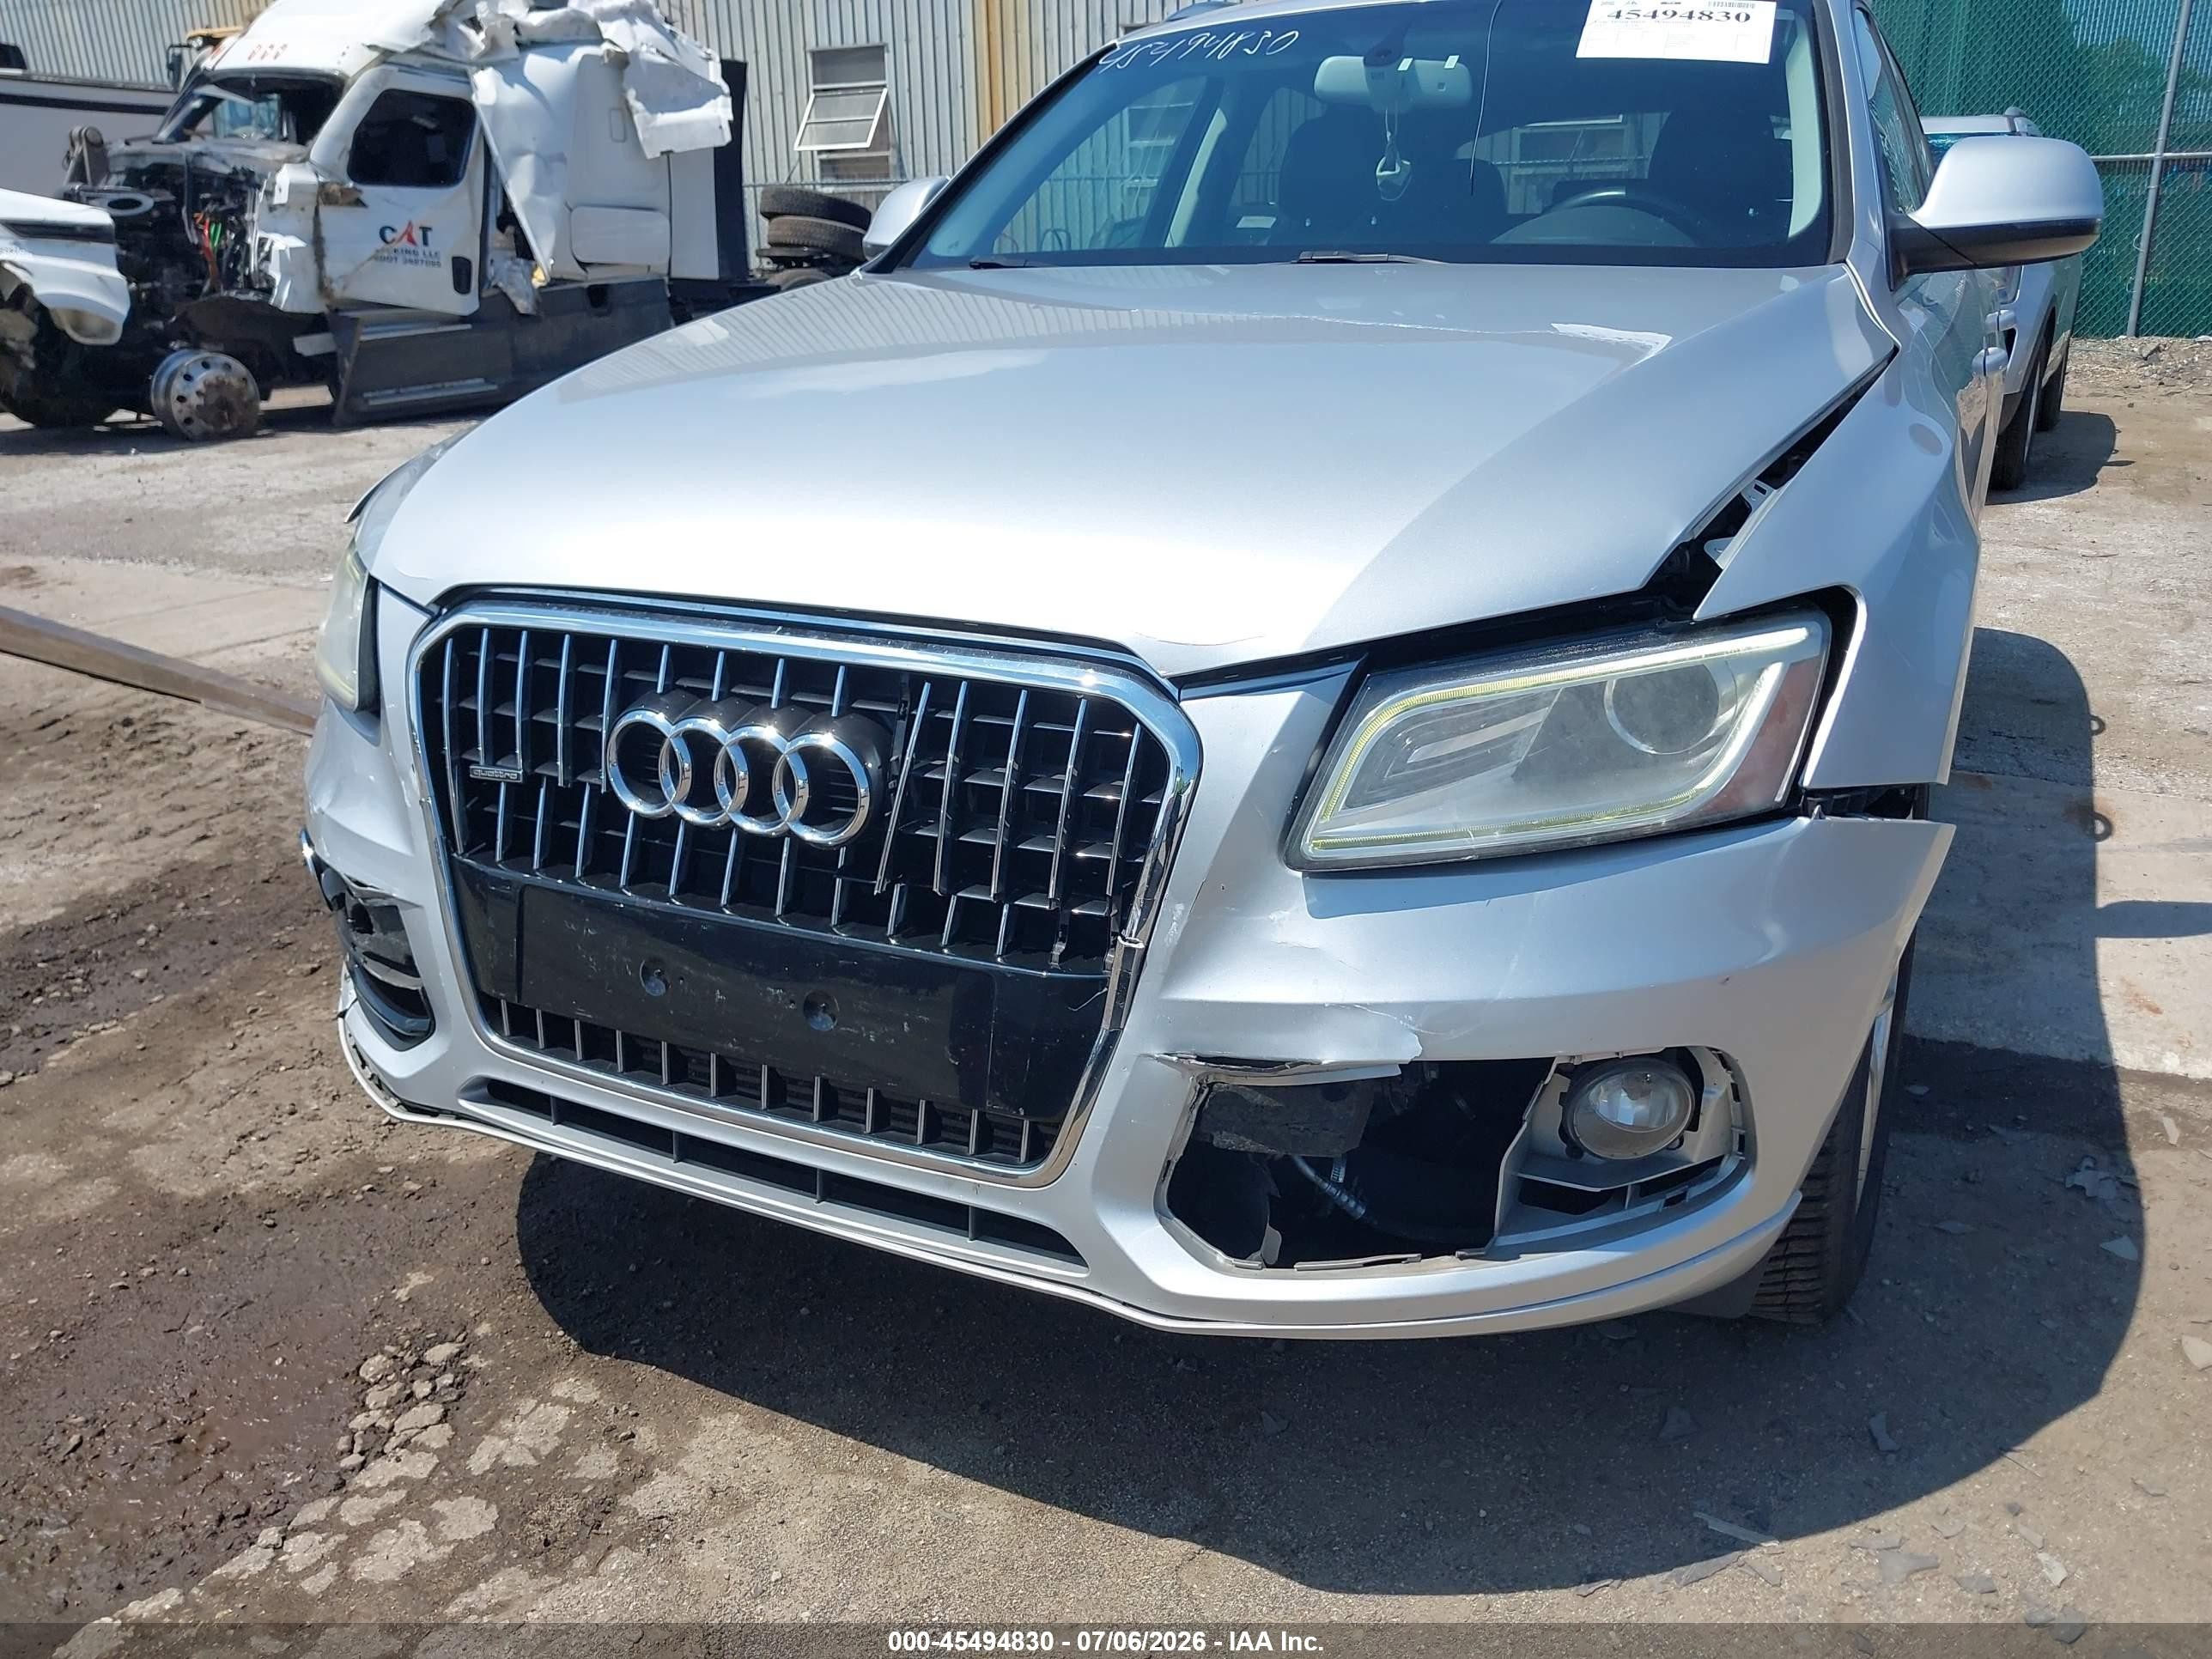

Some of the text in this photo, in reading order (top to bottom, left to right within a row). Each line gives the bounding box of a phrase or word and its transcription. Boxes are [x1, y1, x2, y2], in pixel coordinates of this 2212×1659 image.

[1607, 9, 1751, 23] 45494830
[379, 220, 433, 246] CAT
[473, 769, 518, 780] quattro
